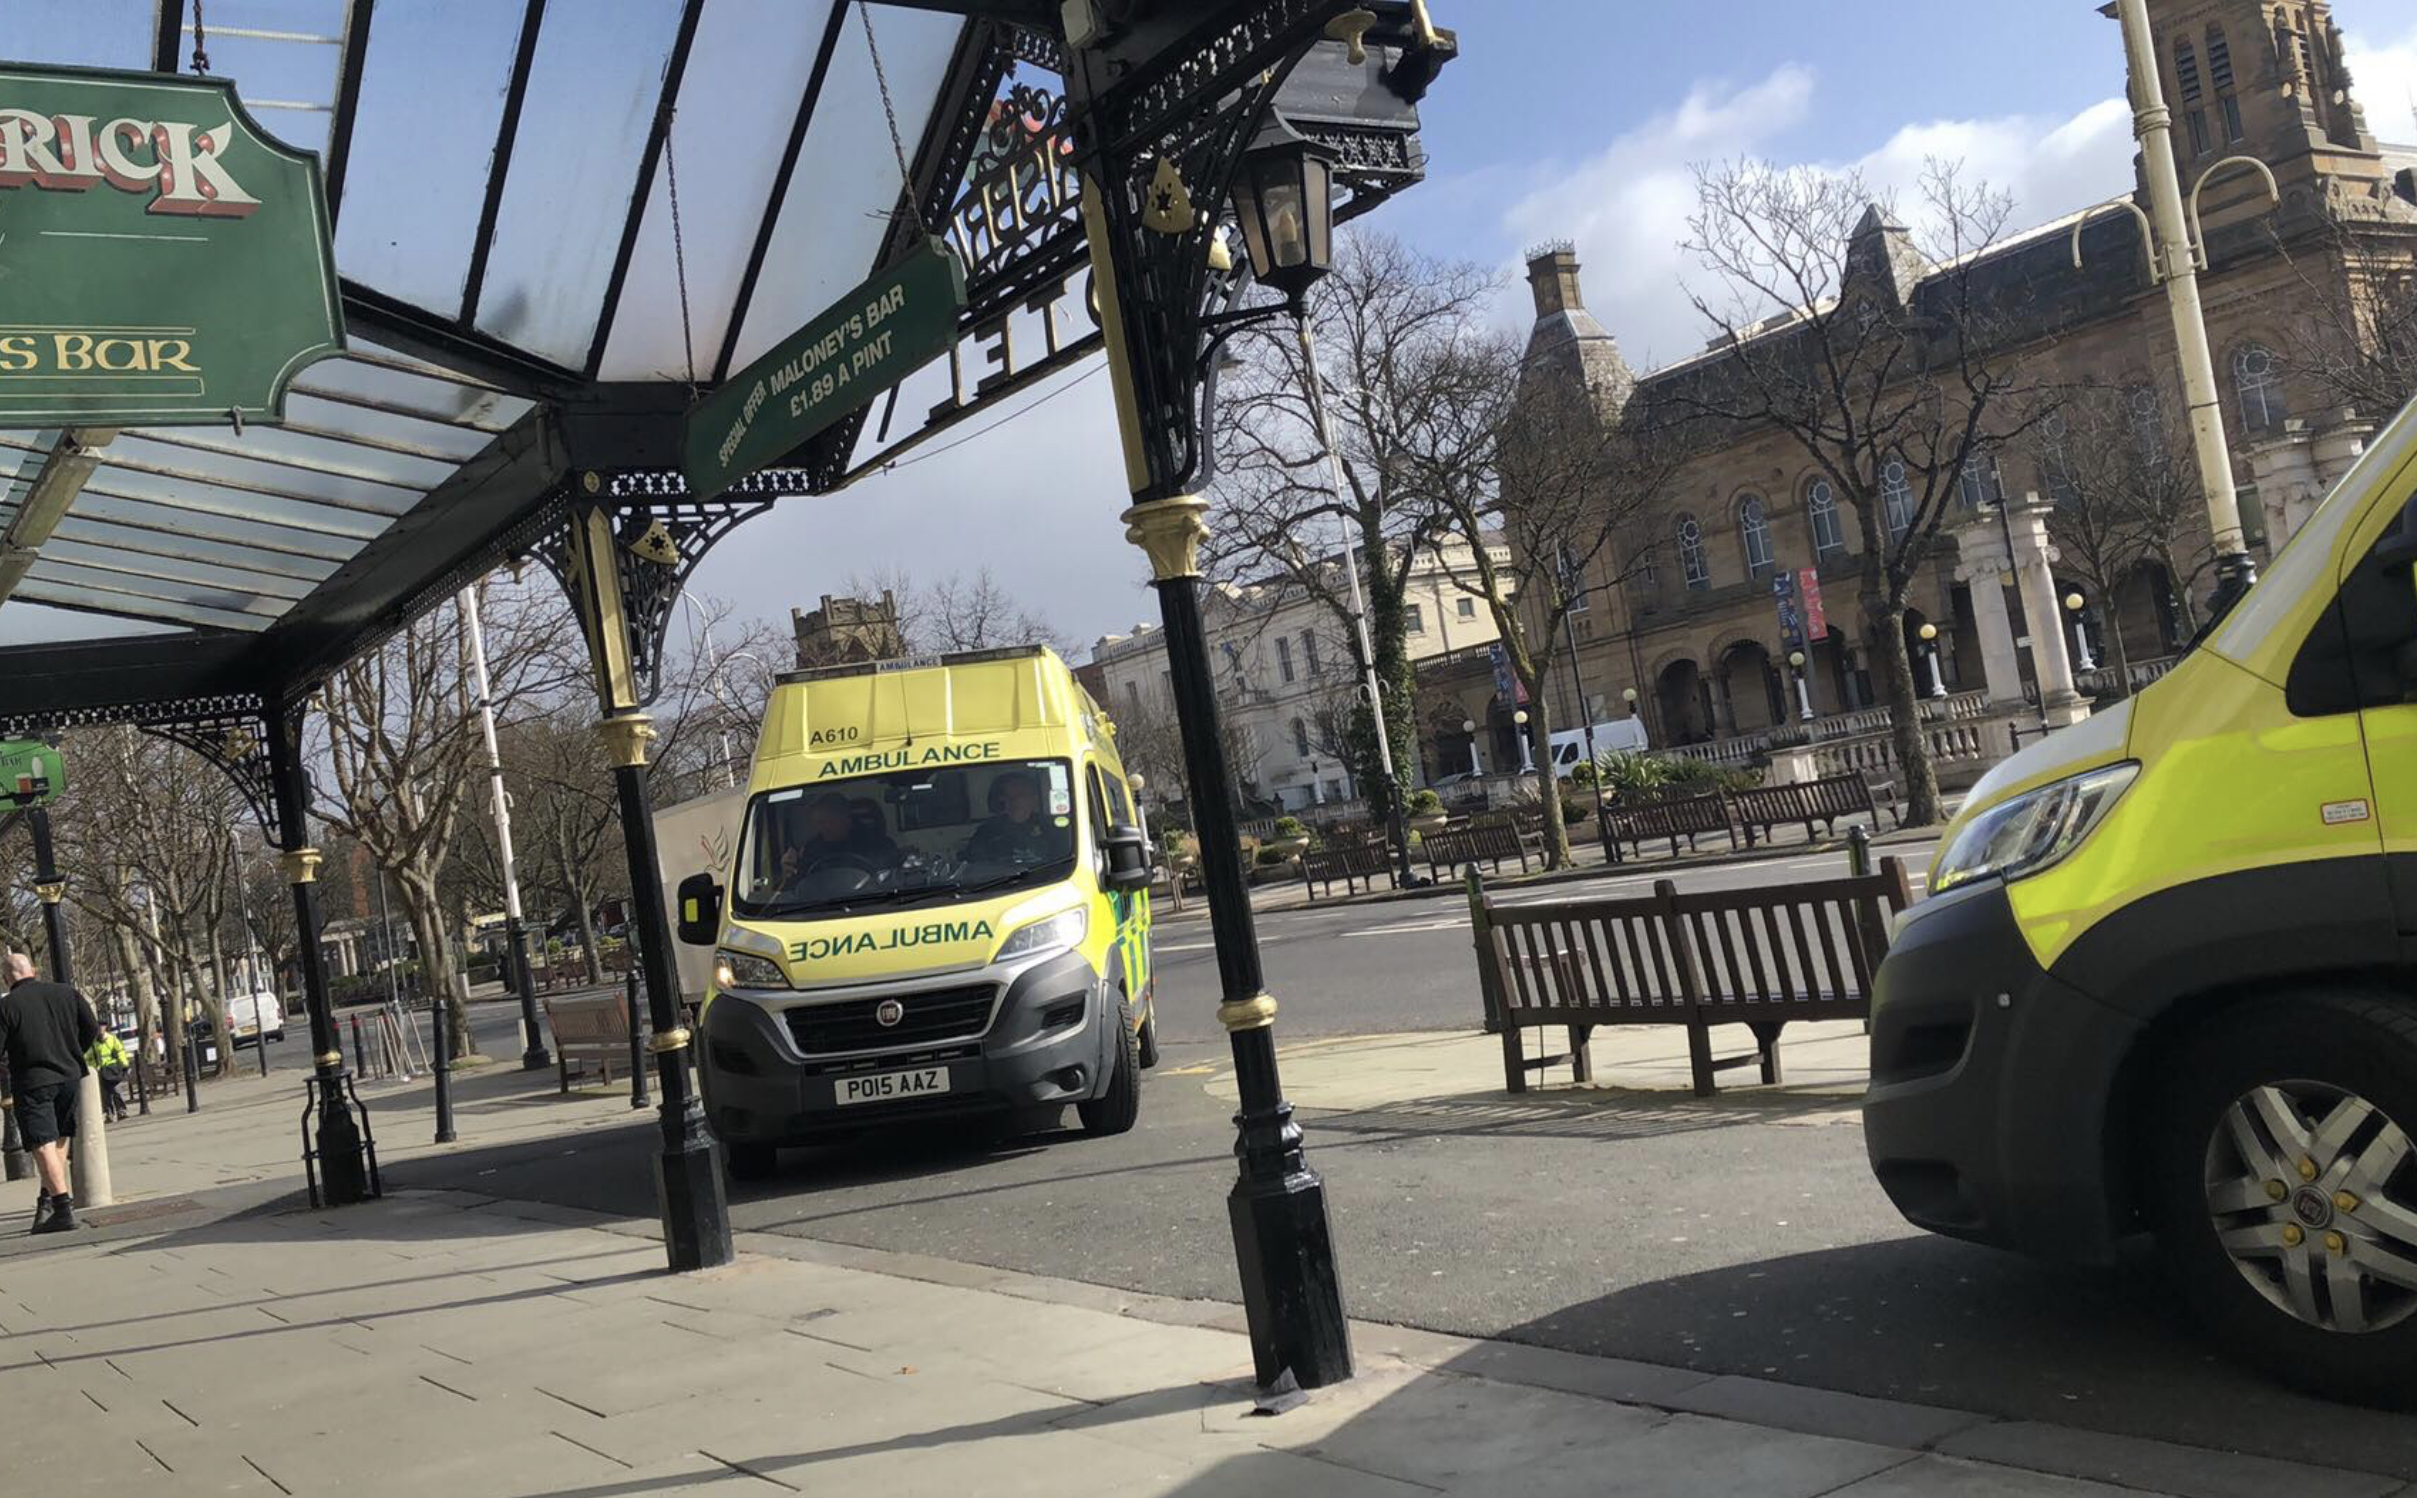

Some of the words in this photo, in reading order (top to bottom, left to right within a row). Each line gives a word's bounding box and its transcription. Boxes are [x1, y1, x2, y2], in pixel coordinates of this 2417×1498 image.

[770, 313, 864, 397] MALONEY'S
[865, 283, 905, 330] BAR
[790, 372, 835, 418] £1.89
[838, 362, 852, 388] A
[852, 329, 893, 376] PINT
[718, 416, 747, 468] SPECIAL
[743, 379, 767, 425] OFFER
[809, 726, 858, 745] A610
[817, 742, 1001, 778] AMBULANCE
[847, 1075, 893, 1100] PO15
[899, 1070, 939, 1093] AAZ
